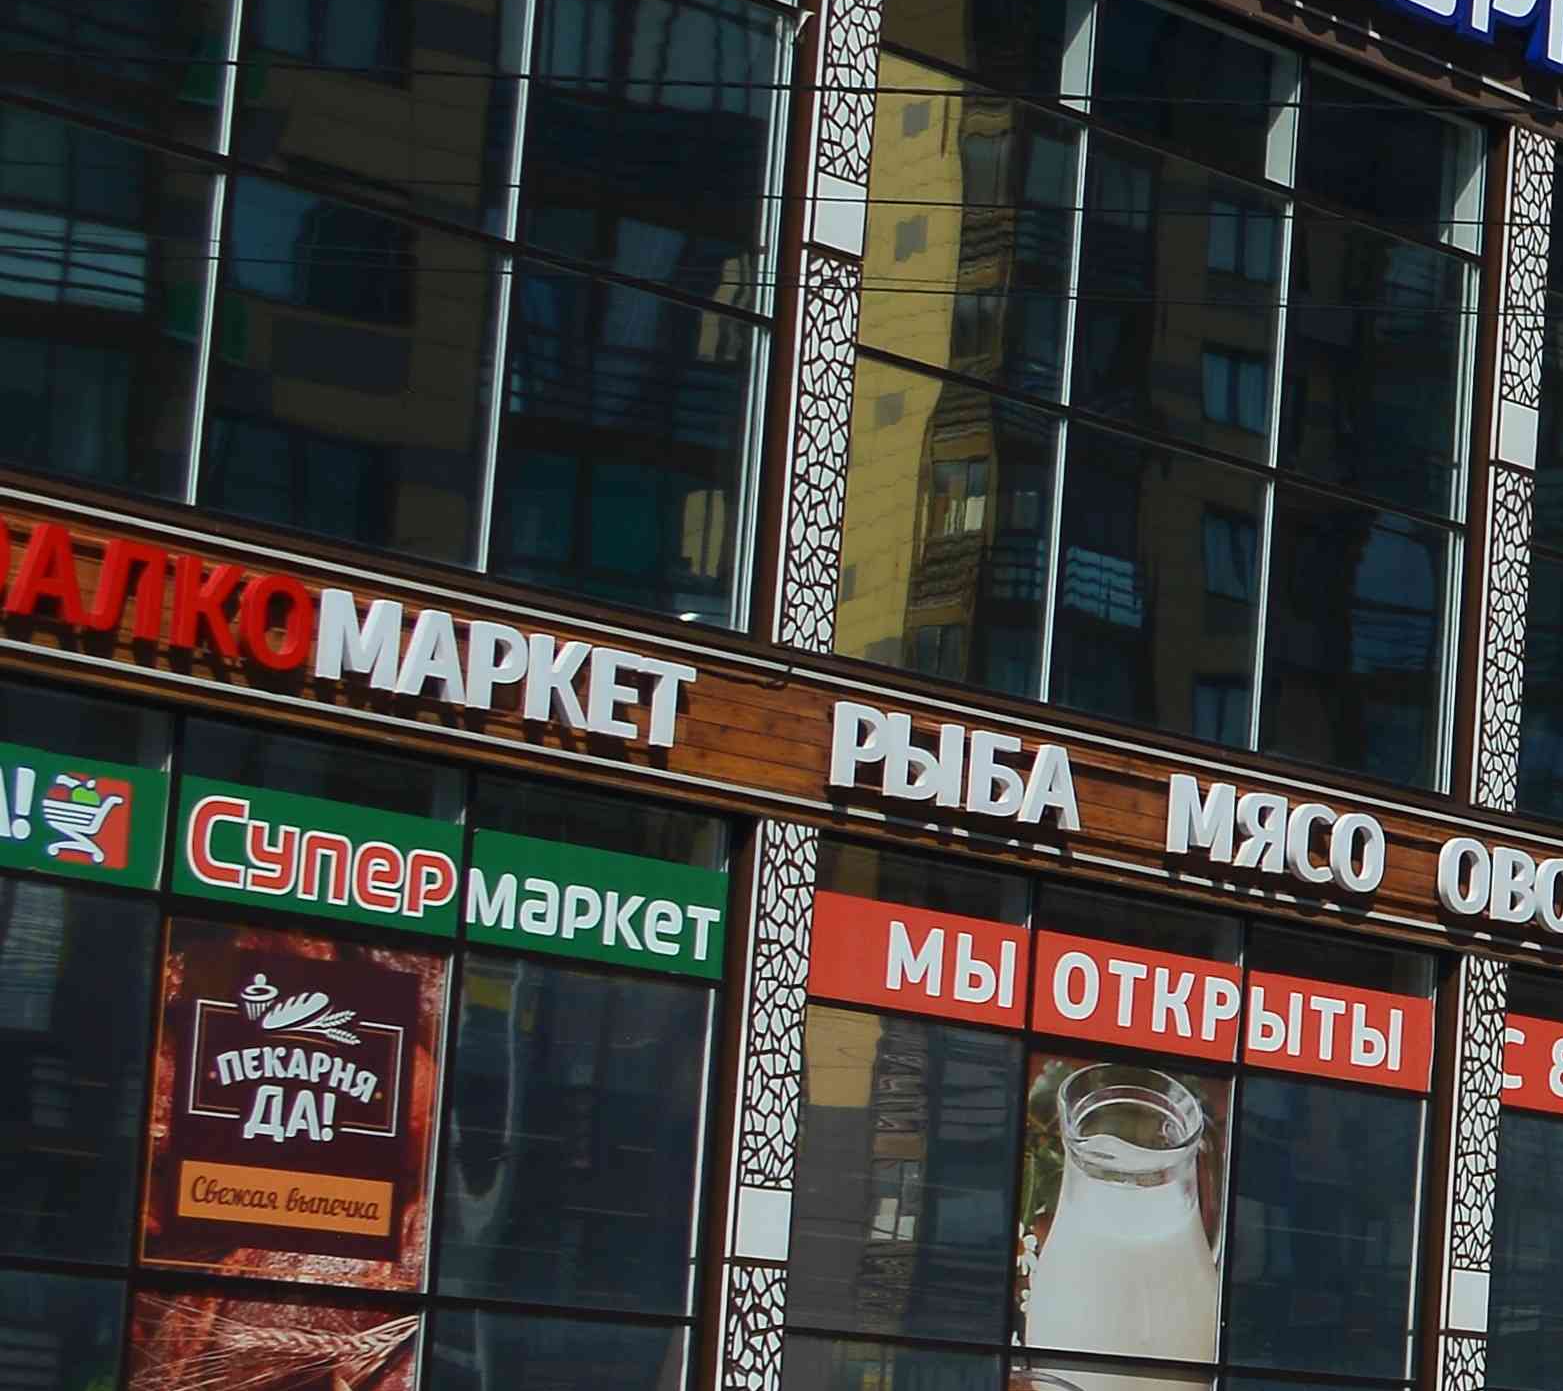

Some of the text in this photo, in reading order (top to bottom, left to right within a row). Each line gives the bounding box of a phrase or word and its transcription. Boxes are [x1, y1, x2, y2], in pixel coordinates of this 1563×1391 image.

[0, 514, 697, 749] АЛКОМАРКЕТ
[829, 701, 1080, 832] РЫБА
[1165, 773, 1386, 894] МЯСО
[185, 793, 720, 962] Супермаркет
[886, 920, 1404, 1072] МЫ ОТКРЫТЫ
[216, 1044, 379, 1105] ПЕКАРНЯ
[242, 1083, 335, 1142] ДА!
[189, 1174, 381, 1223] Свежая выпечка
